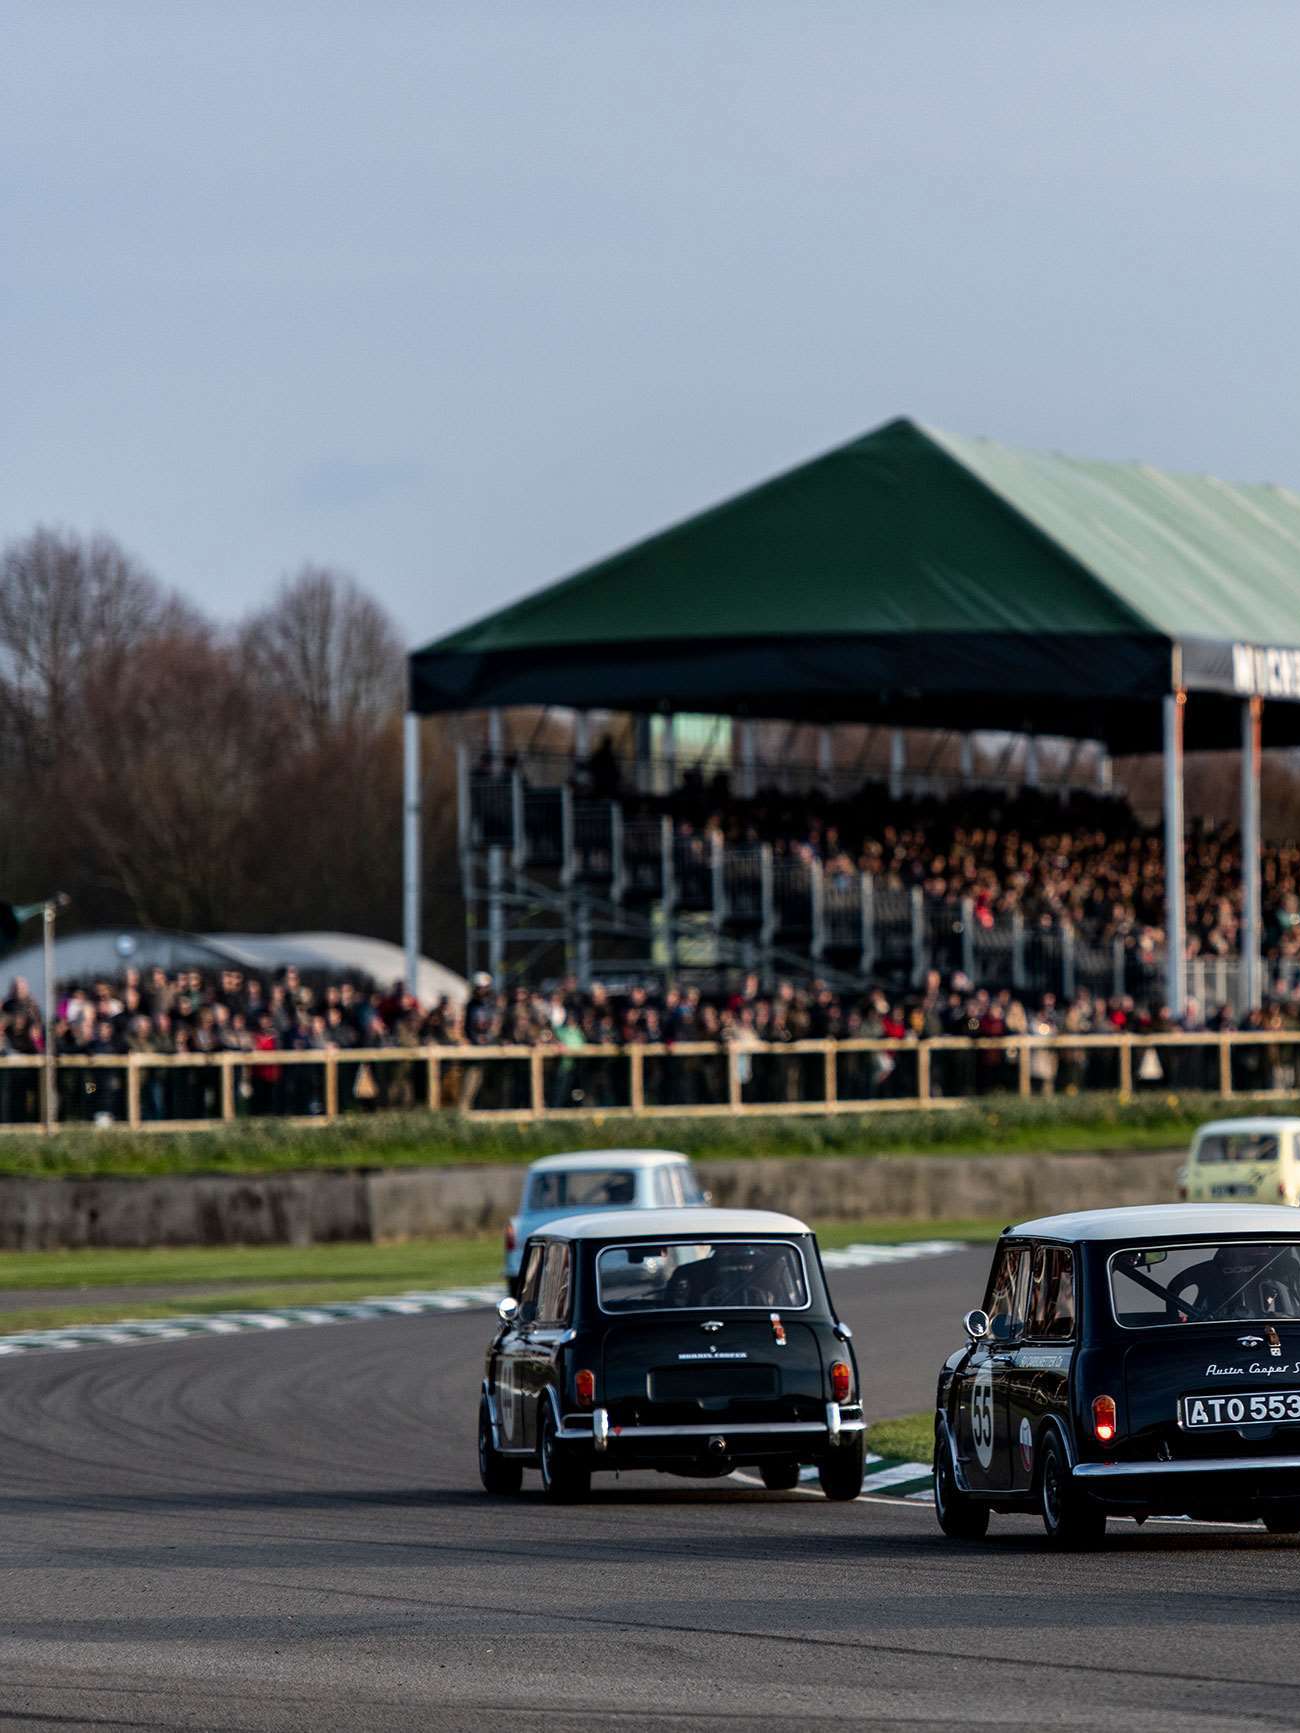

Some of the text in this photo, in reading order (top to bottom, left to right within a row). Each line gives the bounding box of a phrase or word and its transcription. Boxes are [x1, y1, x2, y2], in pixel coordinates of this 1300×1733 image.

[1206, 1361, 1300, 1376] Austin Cooper S
[974, 1385, 992, 1448] 55
[1191, 1398, 1245, 1424] ATO
